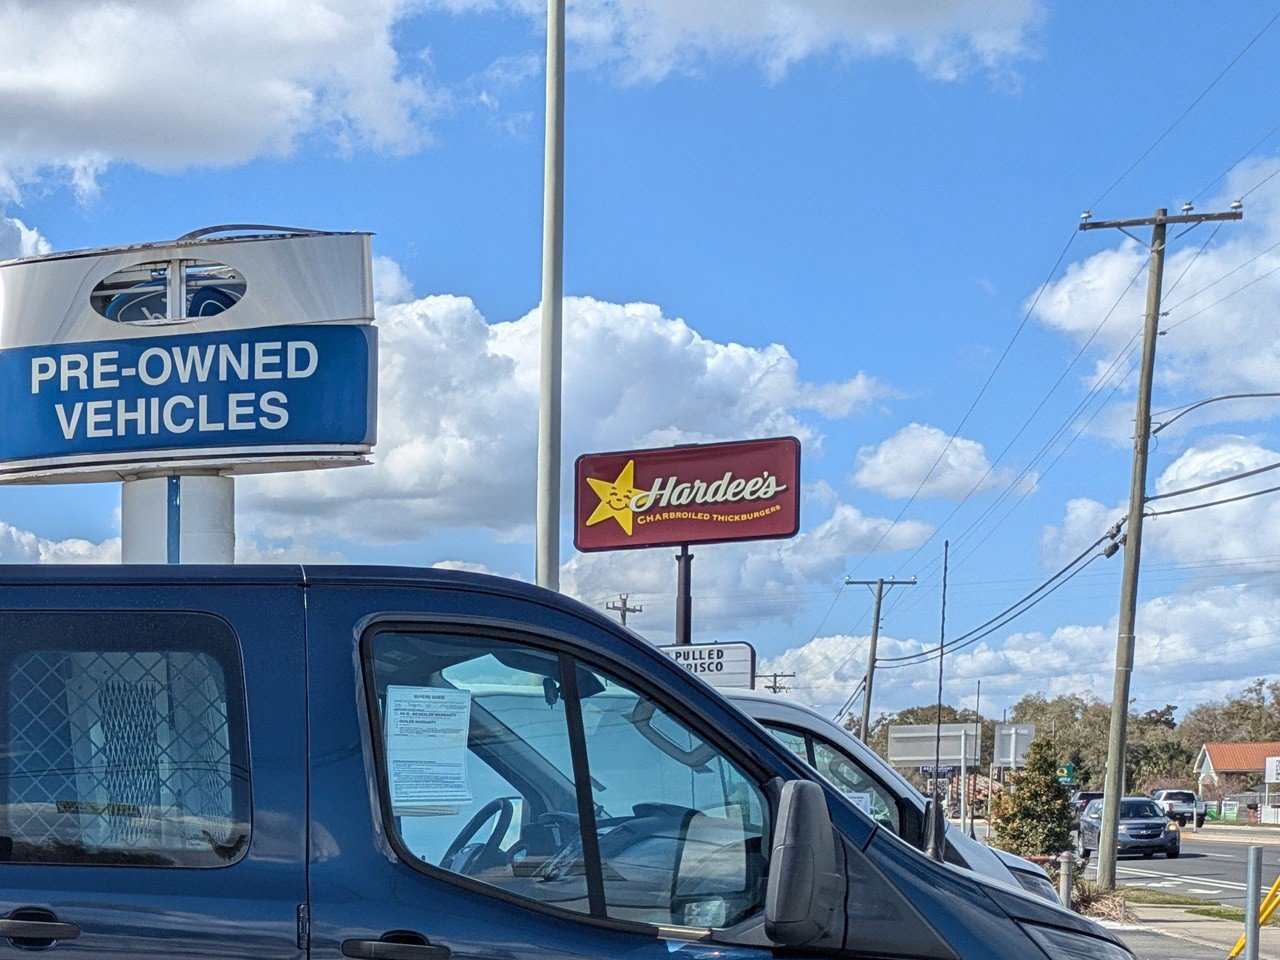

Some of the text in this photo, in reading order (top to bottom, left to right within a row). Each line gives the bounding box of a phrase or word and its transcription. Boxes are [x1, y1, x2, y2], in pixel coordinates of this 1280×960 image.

[31, 341, 318, 394] PRE-OWNED
[55, 391, 289, 440] VEHICLES
[629, 471, 788, 512] Hardee's
[637, 504, 782, 525] CHARBROILED THICKBURGERS
[675, 649, 724, 661] PULLED
[683, 661, 724, 673] RISCO
